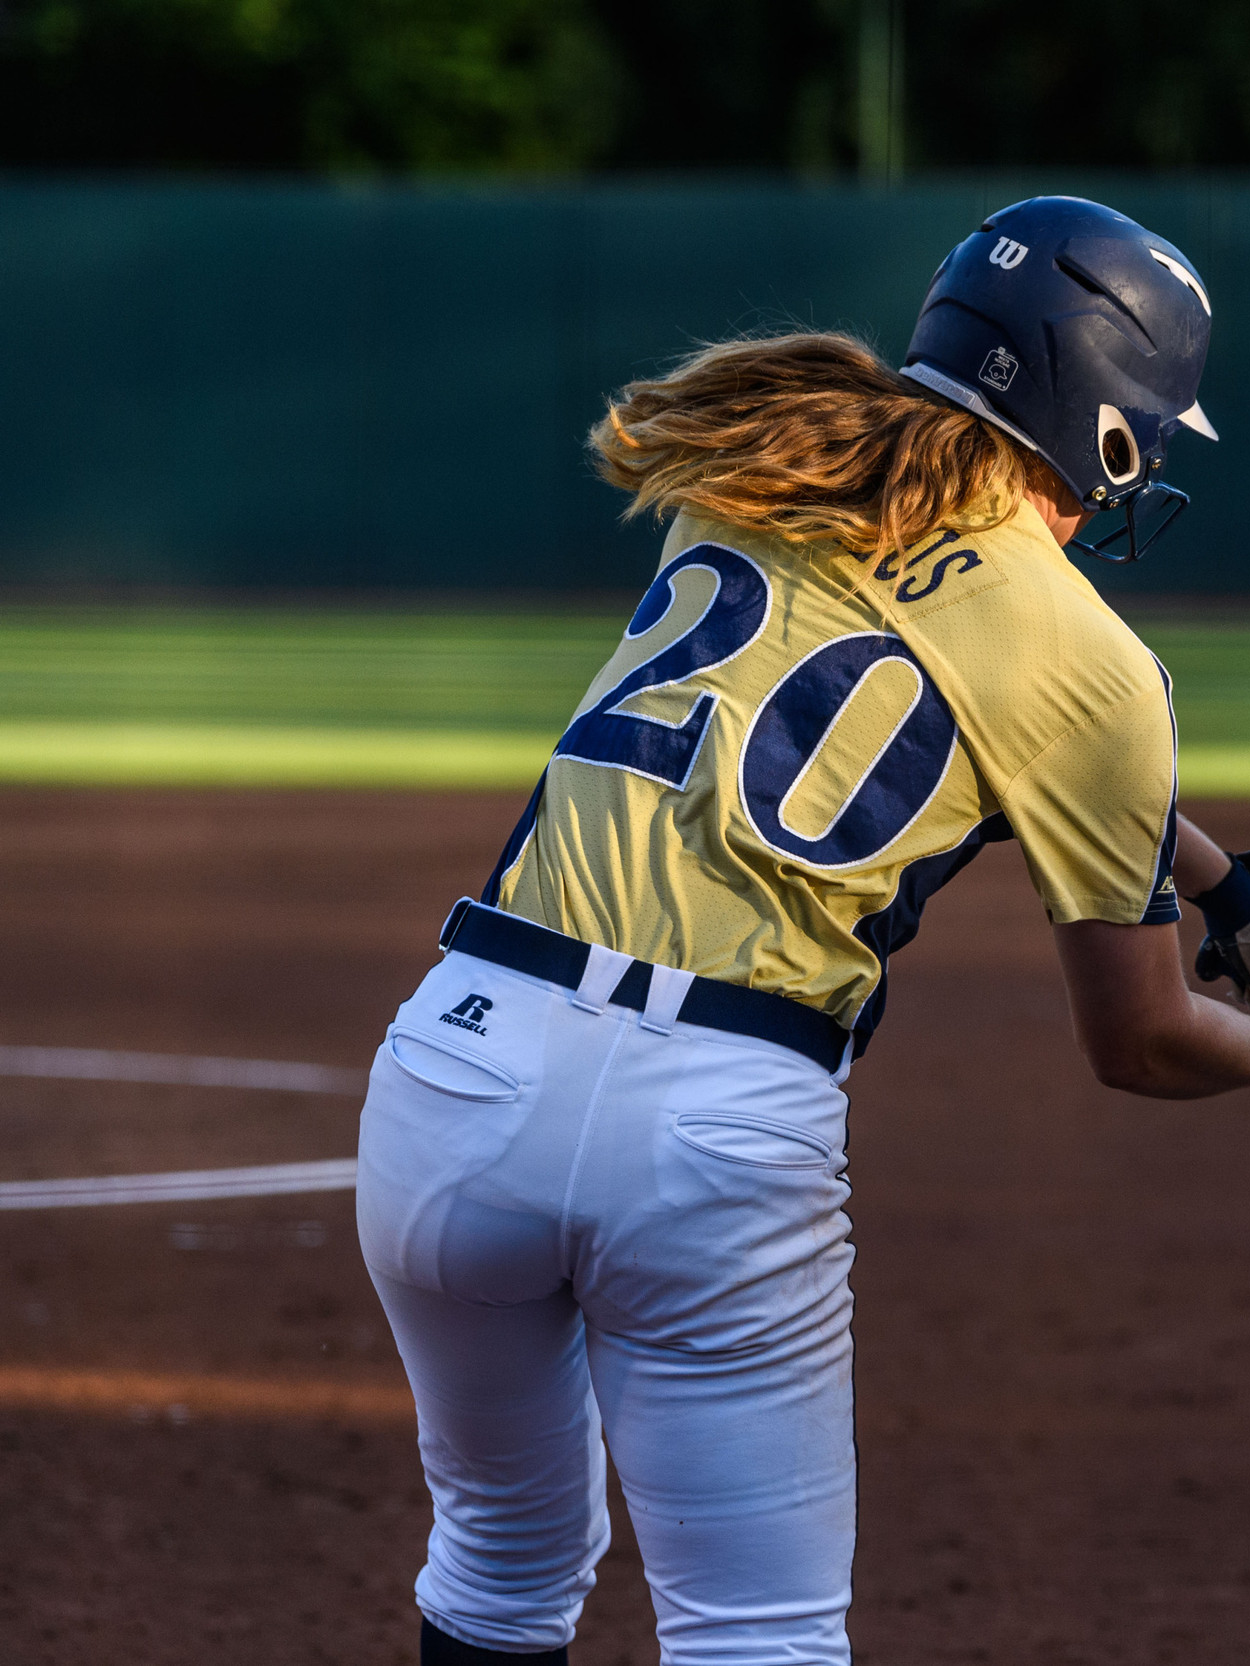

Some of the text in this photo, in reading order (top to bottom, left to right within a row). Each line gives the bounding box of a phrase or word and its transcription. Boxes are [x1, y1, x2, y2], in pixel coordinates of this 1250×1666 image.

[555, 541, 958, 869] 20
[451, 993, 493, 1023] R
[438, 1013, 488, 1037] RUSSELL
